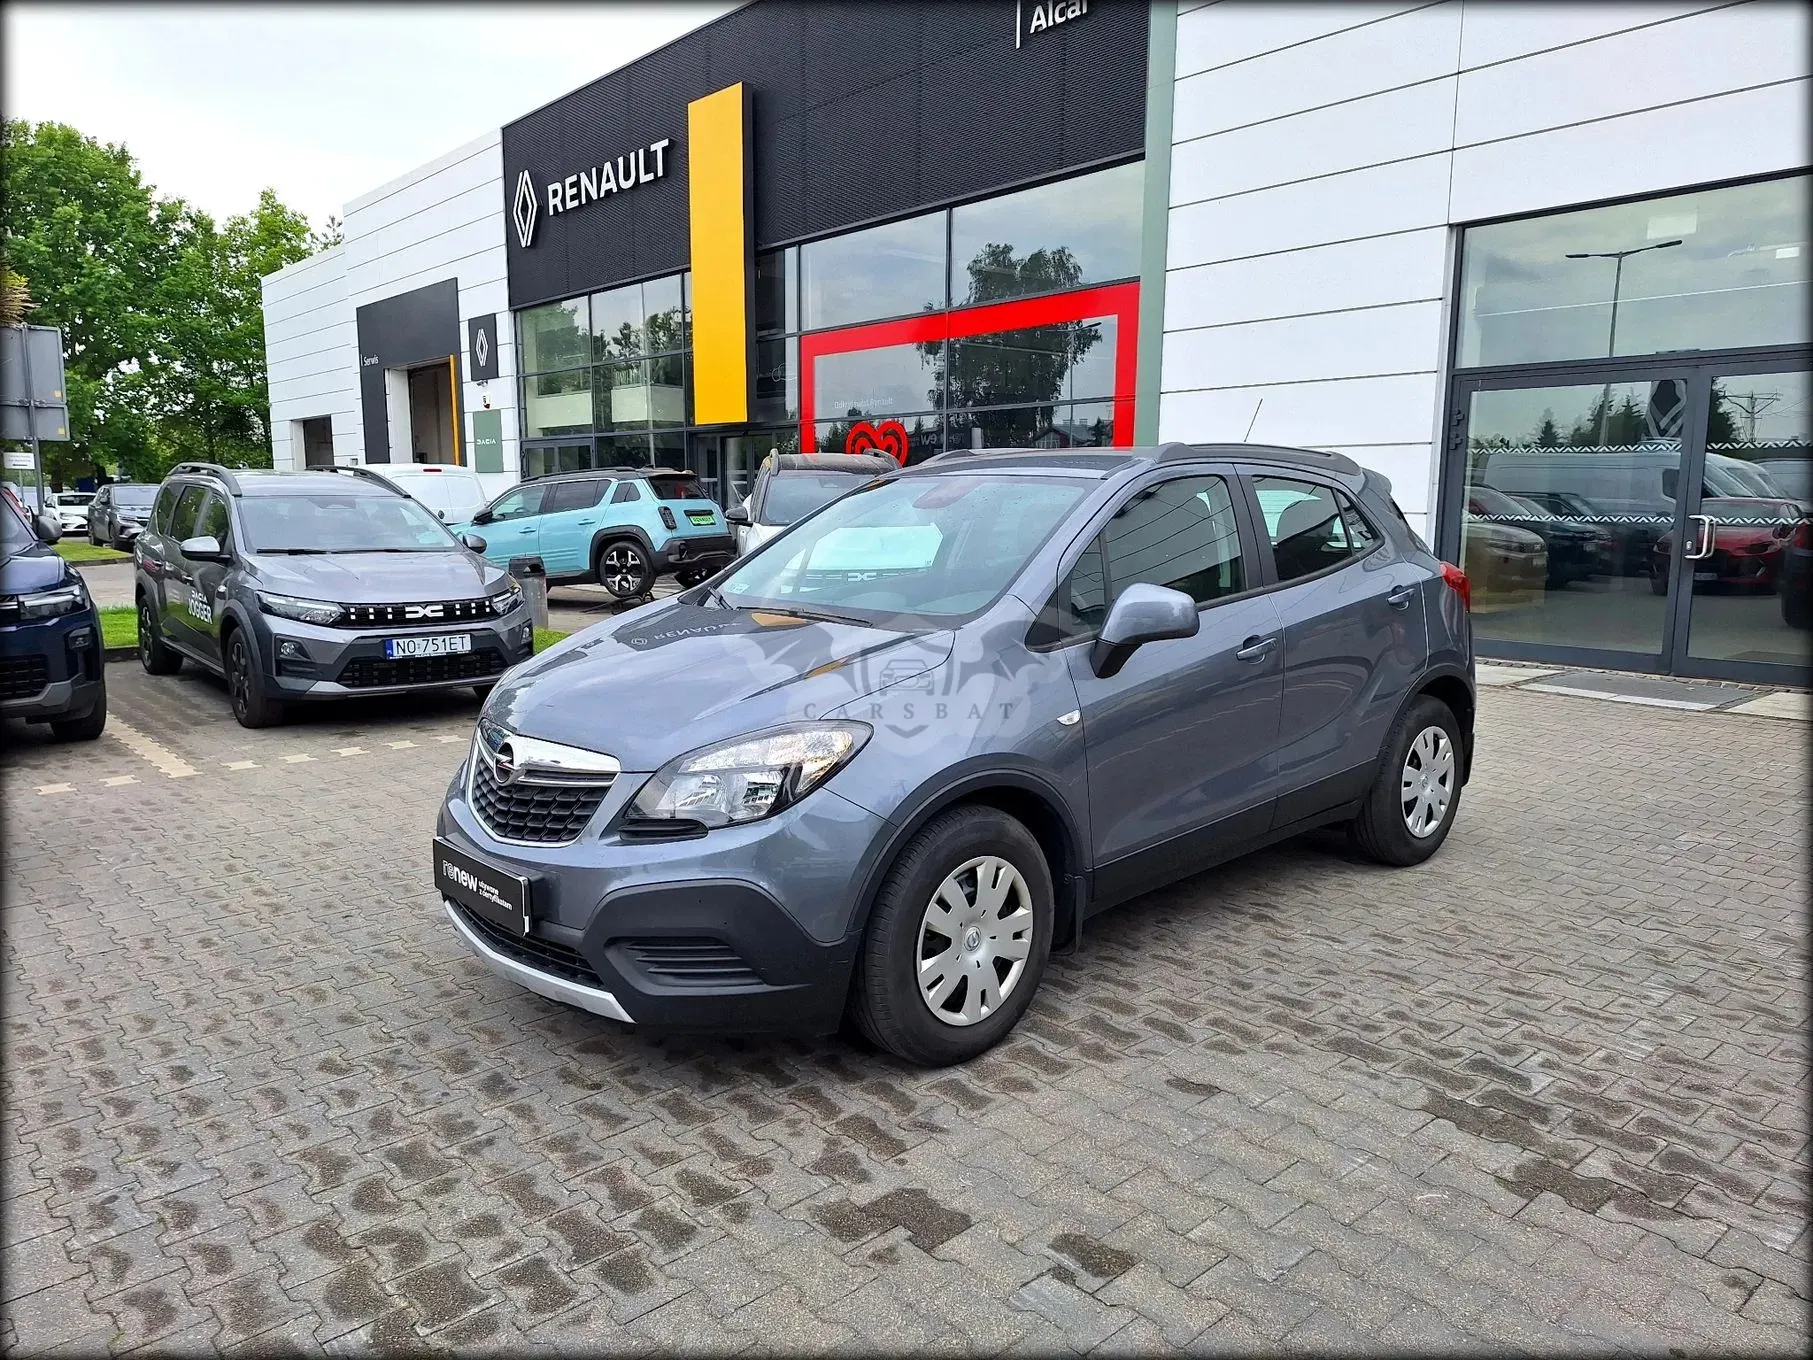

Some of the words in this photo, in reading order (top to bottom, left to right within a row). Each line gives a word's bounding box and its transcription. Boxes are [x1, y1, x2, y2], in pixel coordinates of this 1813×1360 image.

[547, 138, 669, 216] RENAULT
[188, 597, 213, 625] JOGGER
[396, 639, 416, 655] NO
[422, 636, 466, 653] 751ET
[442, 859, 478, 893] renew
